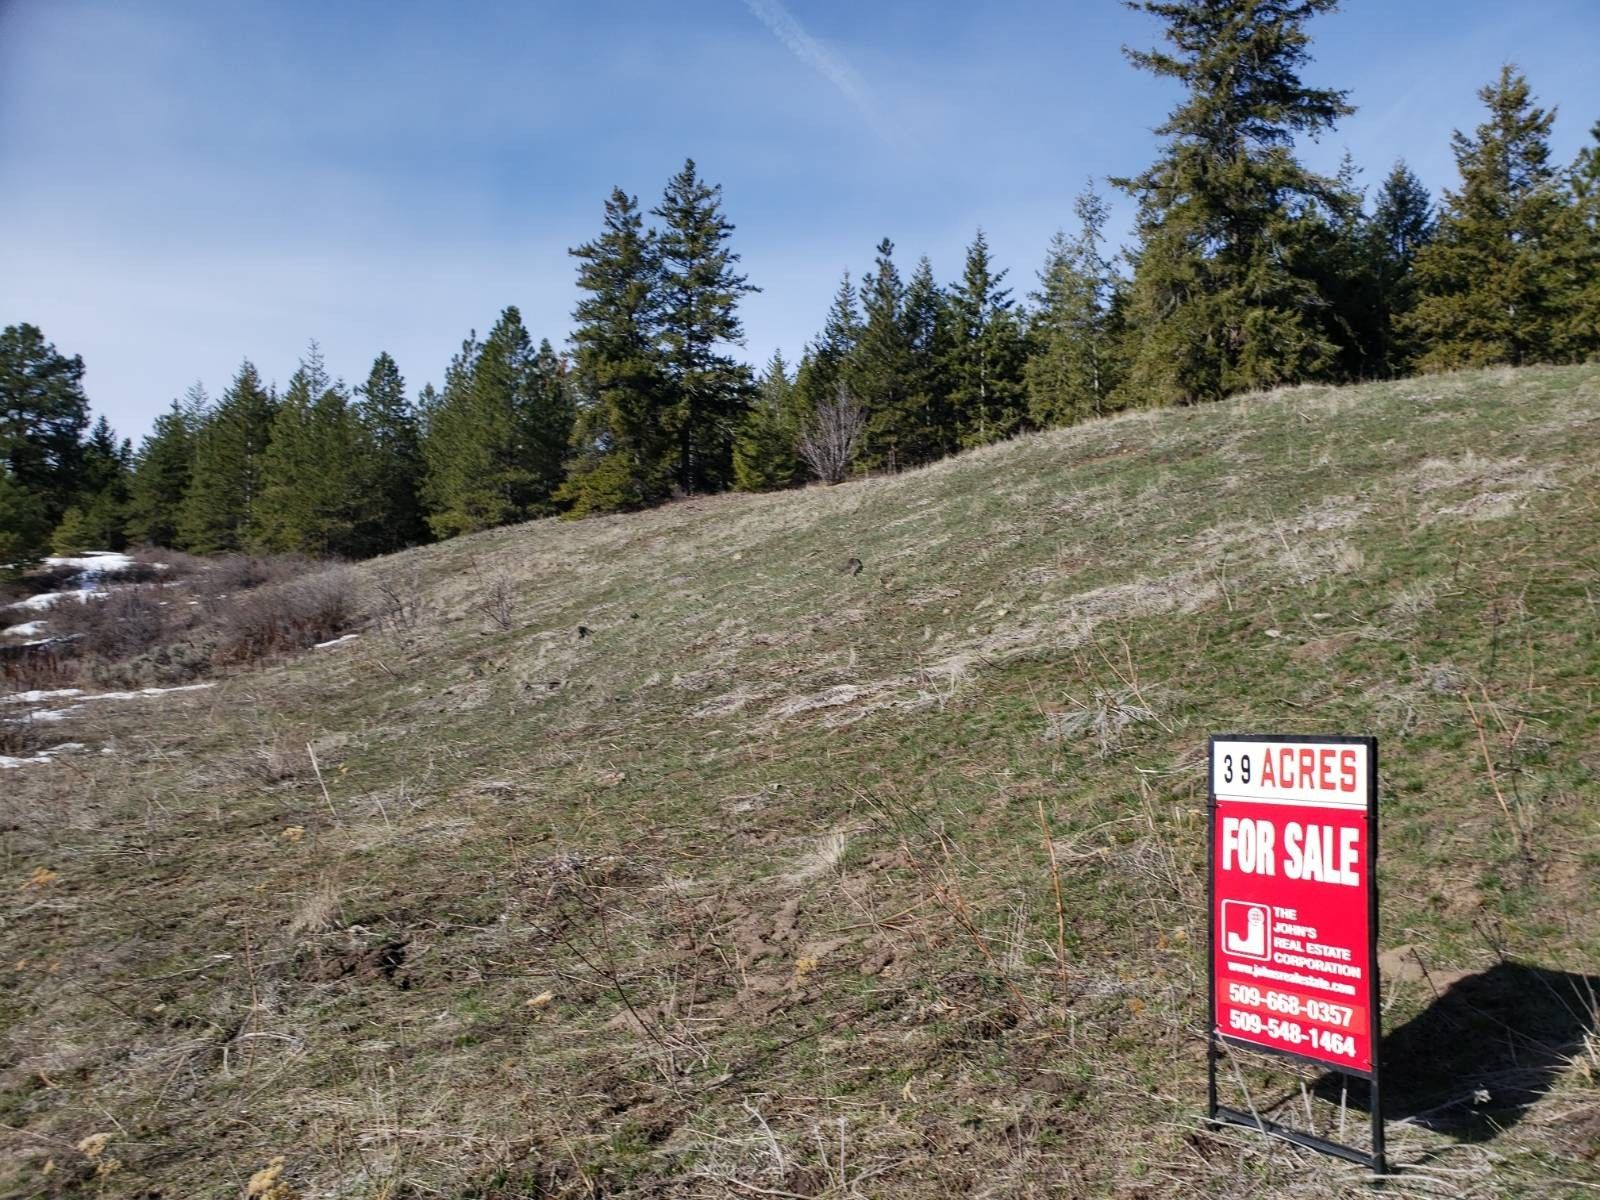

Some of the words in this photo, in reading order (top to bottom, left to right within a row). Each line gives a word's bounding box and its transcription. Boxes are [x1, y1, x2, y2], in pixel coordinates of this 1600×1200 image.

[1224, 754, 1251, 784] 39
[1260, 747, 1356, 792] ACRES
[1222, 817, 1276, 876] FOR
[1283, 821, 1360, 887] SALE
[1273, 906, 1297, 920] THE
[1273, 922, 1317, 939] JOHN'S
[1273, 936, 1305, 952] REAL
[1306, 942, 1352, 961] ESTATE
[1273, 952, 1362, 979] CORPORATION
[1229, 983, 1353, 1027] 509-668-0357
[1229, 1009, 1357, 1058] 509-548-1464
